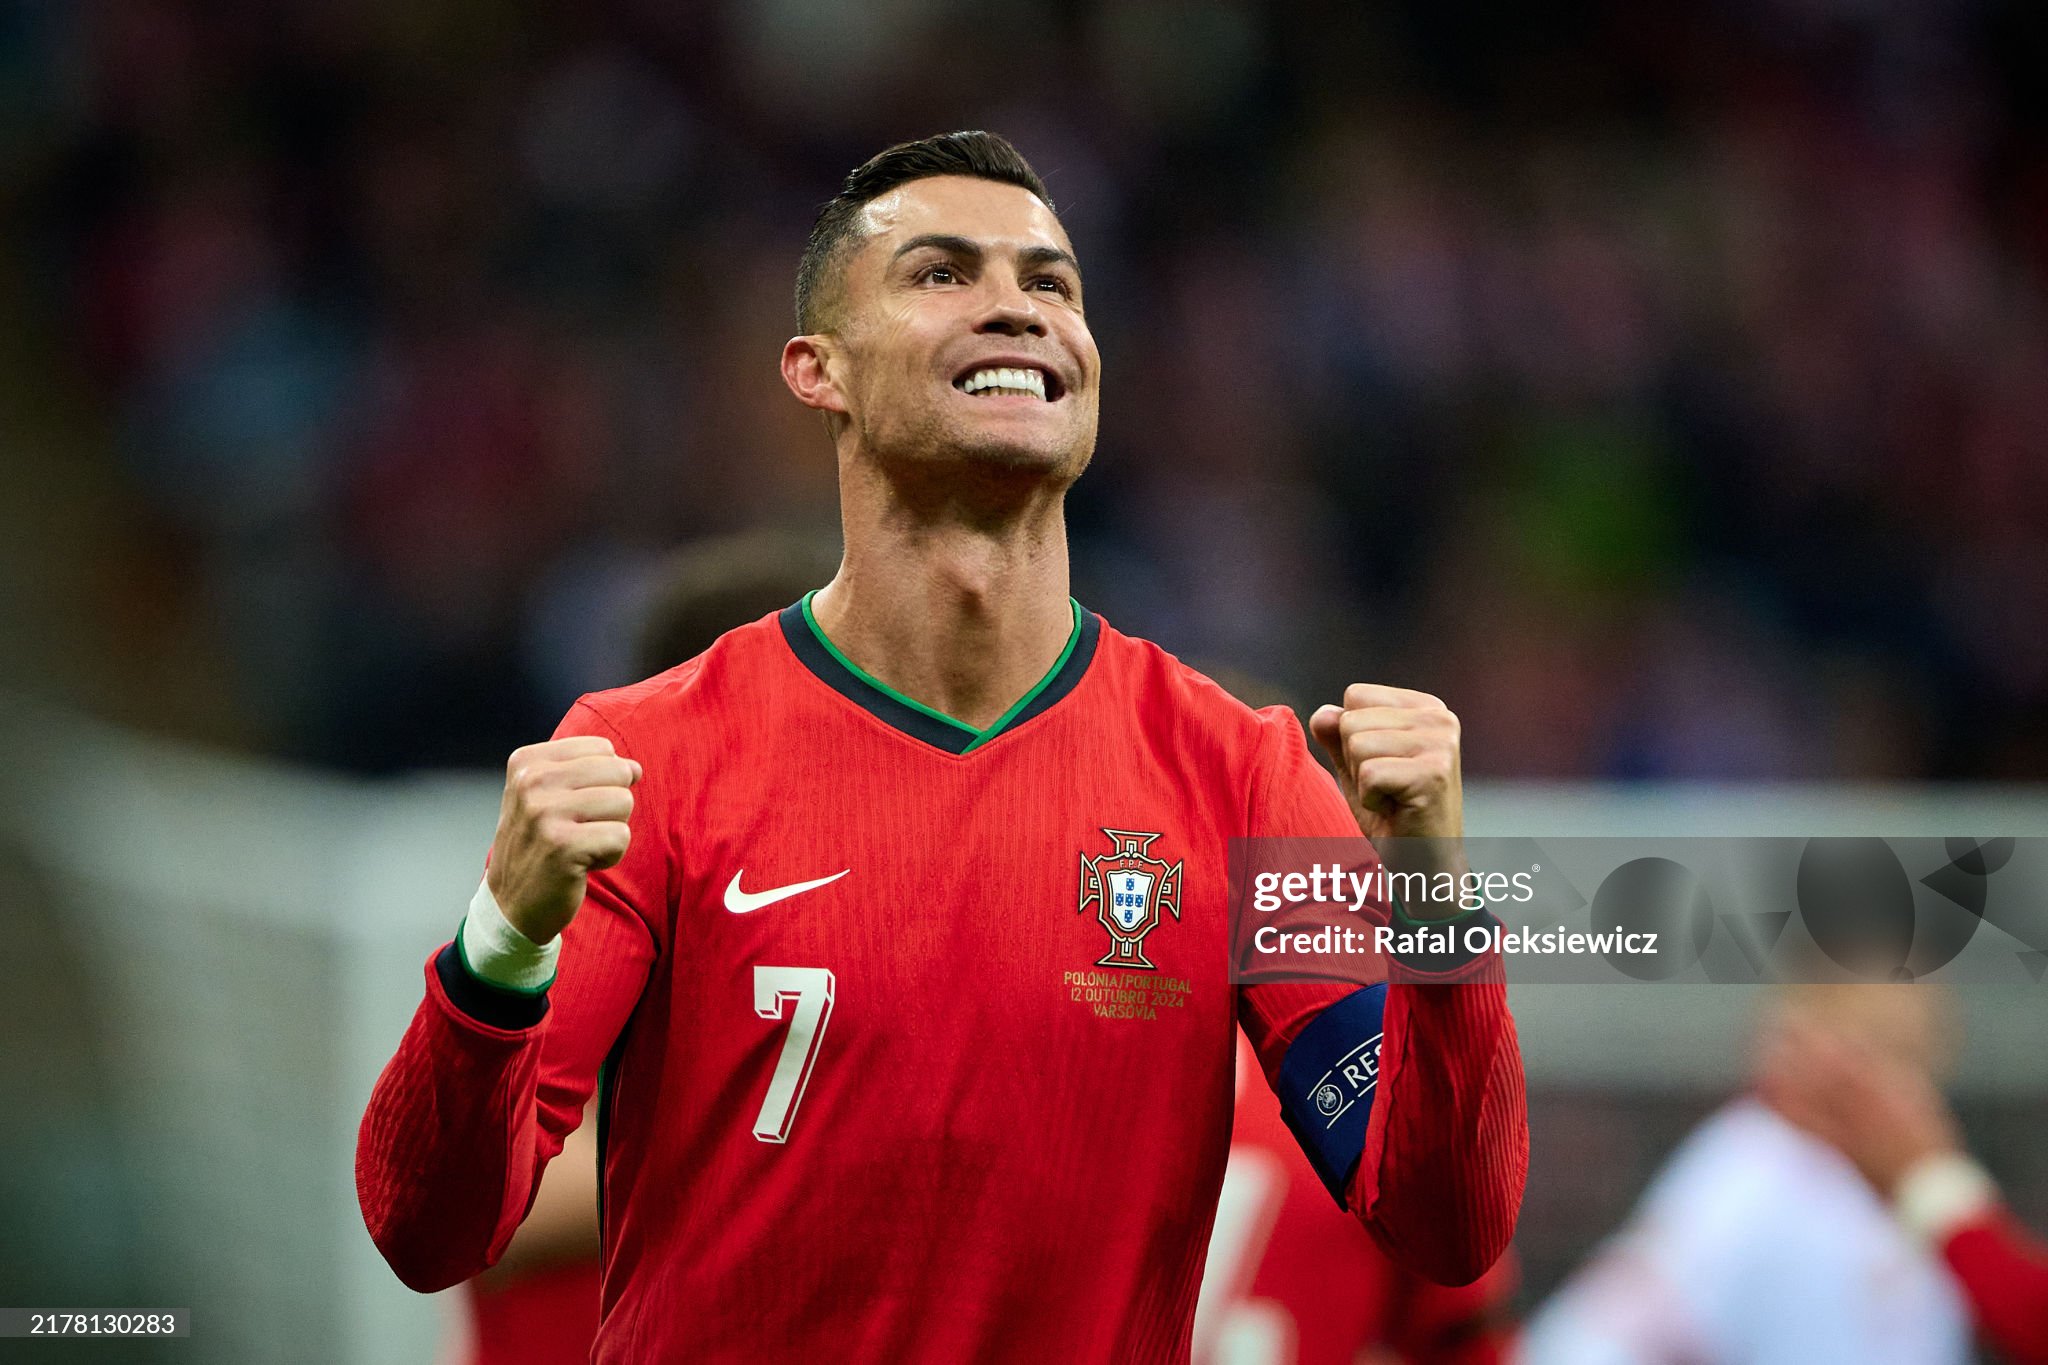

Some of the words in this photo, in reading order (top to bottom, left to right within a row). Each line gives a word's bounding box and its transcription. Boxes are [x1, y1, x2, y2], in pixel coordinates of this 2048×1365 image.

[1071, 987, 1081, 1002] 12
[1085, 988, 1147, 1005] OUTUBRO
[1151, 991, 1185, 1008] 2024
[752, 966, 836, 1144] 7
